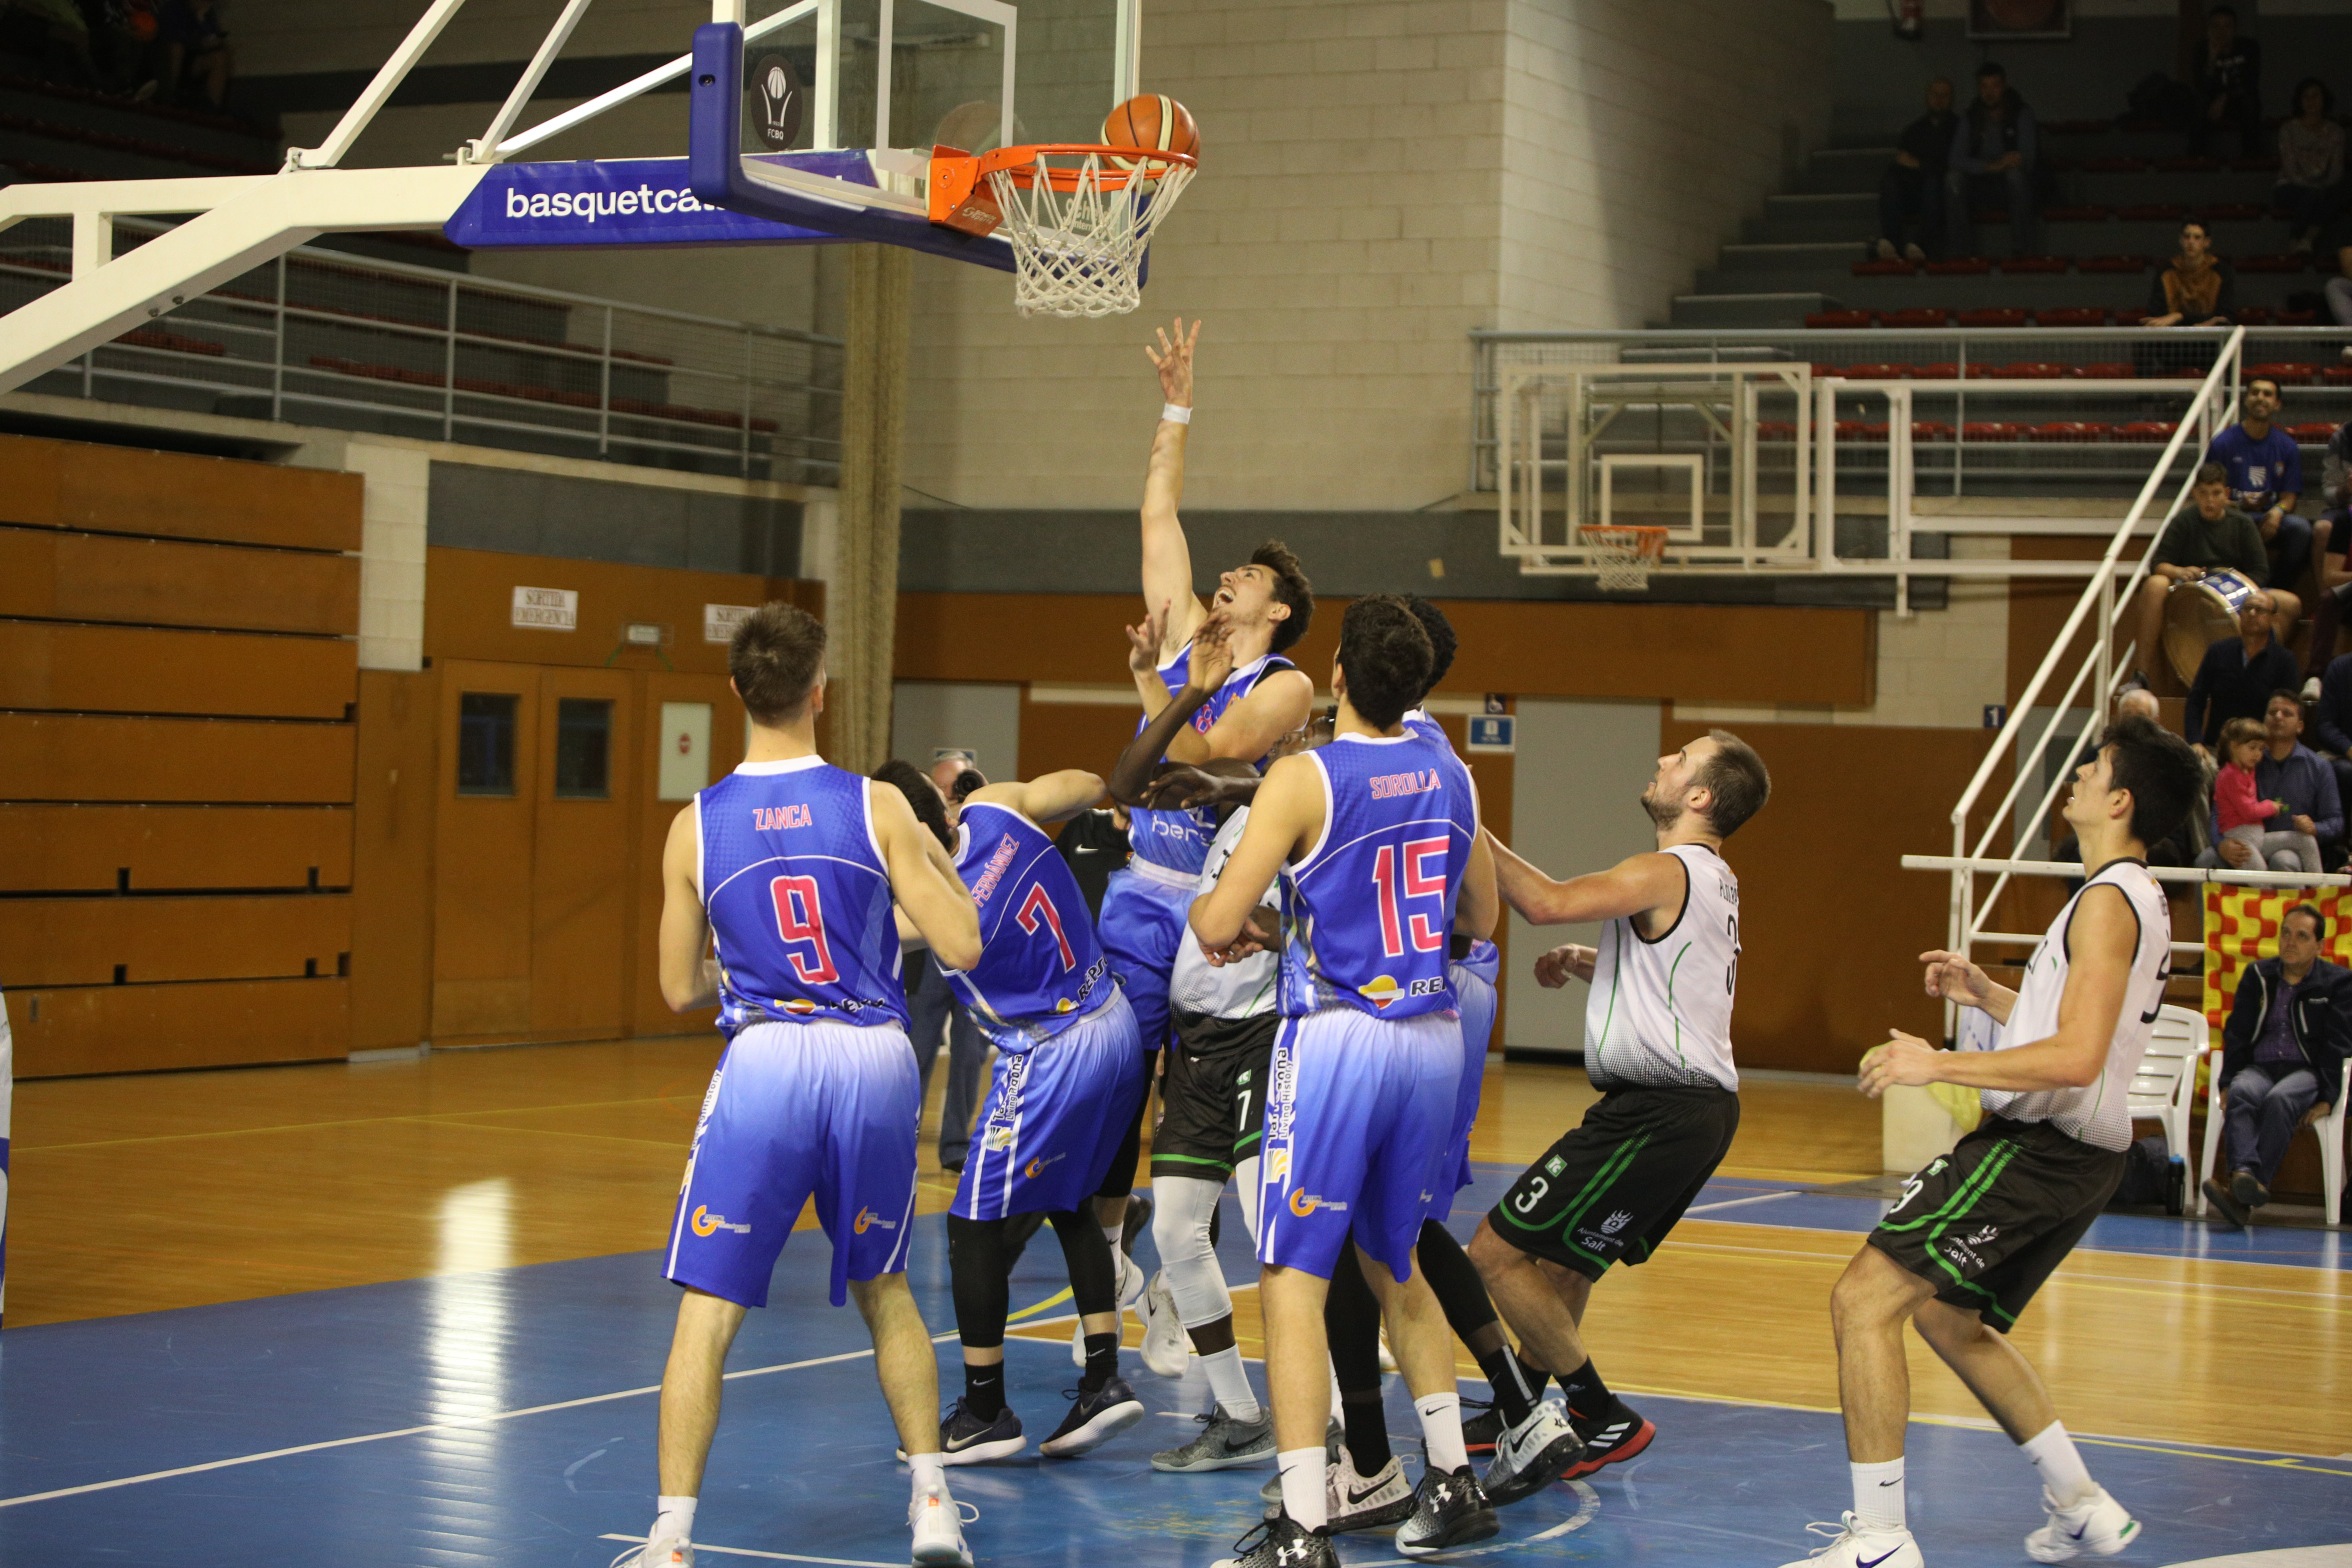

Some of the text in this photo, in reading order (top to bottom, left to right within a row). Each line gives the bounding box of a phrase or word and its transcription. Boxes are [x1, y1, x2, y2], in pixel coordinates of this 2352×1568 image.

[767, 128, 784, 141] FCBQ
[506, 183, 725, 222] basquetca
[1370, 768, 1441, 799] SOROLLA
[753, 804, 812, 831] ZANCA
[1372, 835, 1450, 958] 15
[770, 875, 840, 985] 9
[1015, 881, 1077, 974] 7
[1238, 1089, 1252, 1132] 7
[1514, 1176, 1549, 1213] 3
[1581, 1236, 1607, 1252] Salt
